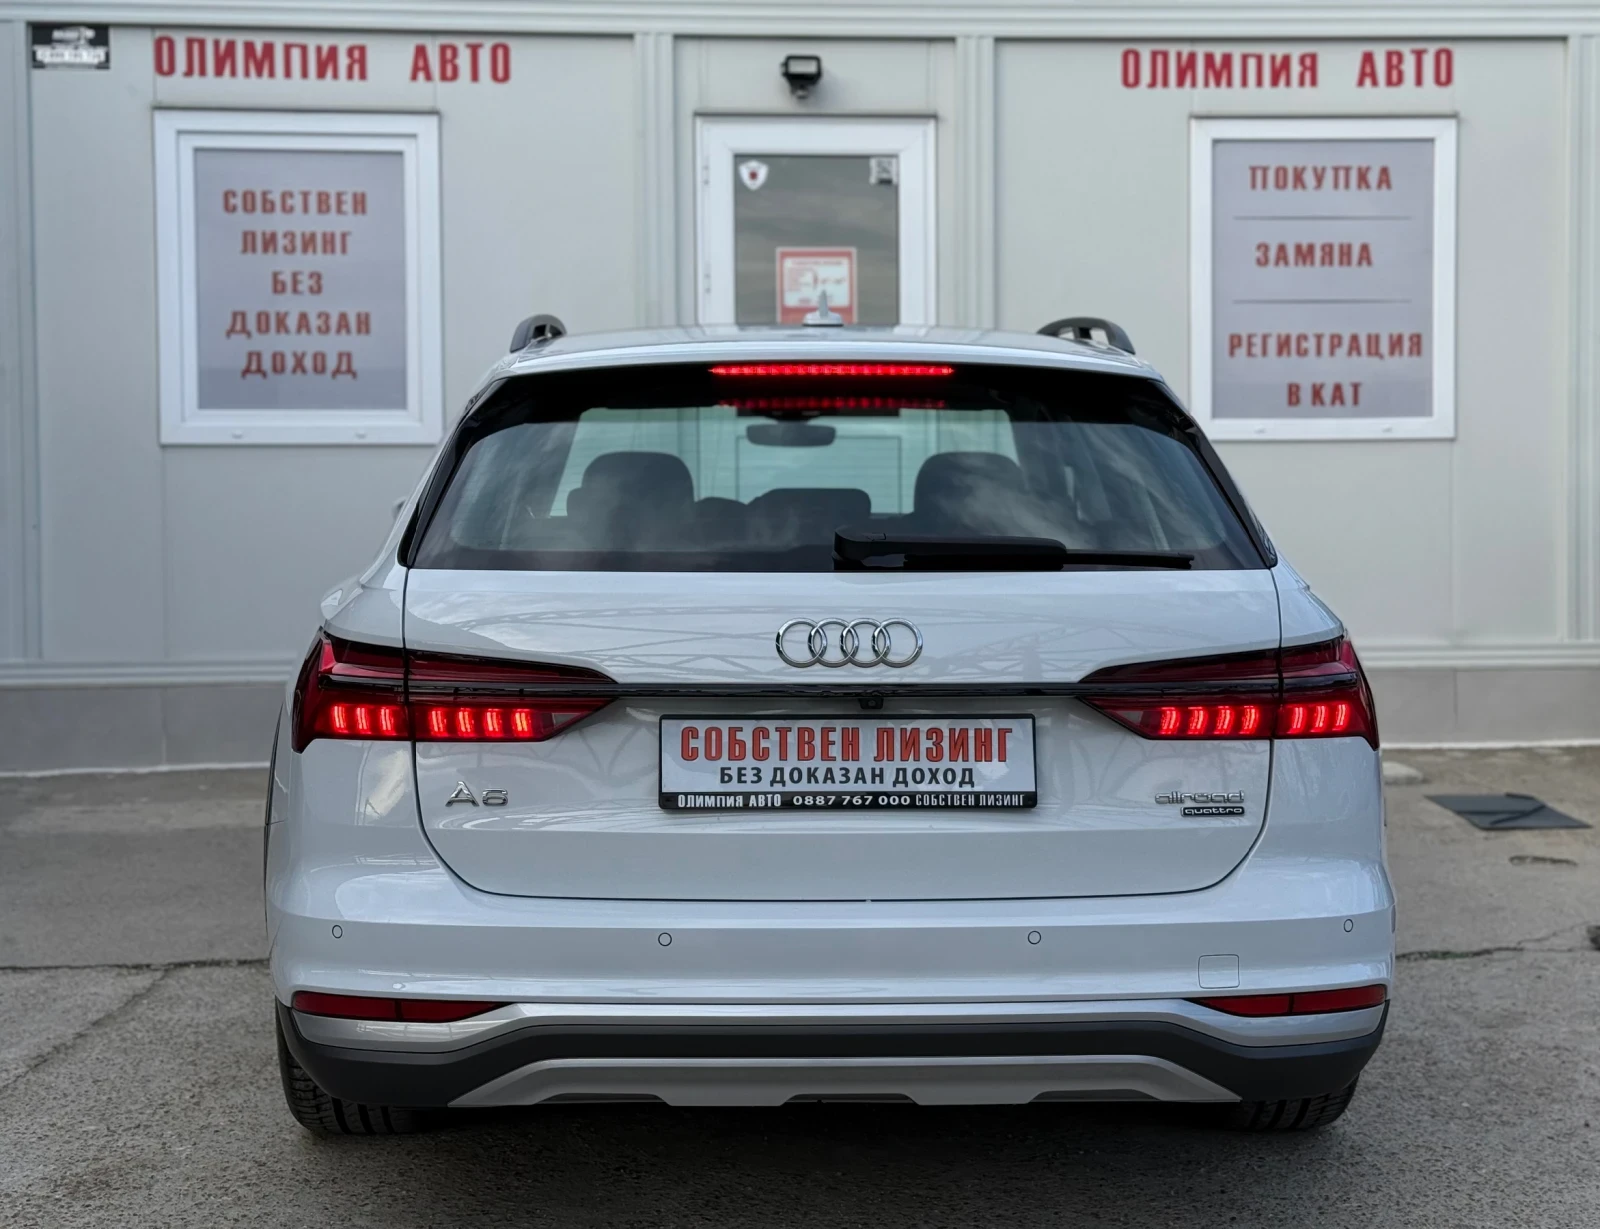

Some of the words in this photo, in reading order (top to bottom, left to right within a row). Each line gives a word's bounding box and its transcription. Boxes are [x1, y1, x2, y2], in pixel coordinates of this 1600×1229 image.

[154, 35, 368, 82] ОЛИМПИЯ
[410, 42, 512, 84] АВТО
[1121, 48, 1319, 89] ОЛИМПИЯ
[1356, 47, 1455, 88] АВТО
[1249, 165, 1393, 190] ПОКУПКА
[223, 190, 368, 216] СОБСТВЕН
[240, 231, 352, 255] ЛИЗИНГ
[1255, 242, 1373, 268] ЗАМЯНА
[272, 271, 324, 296] БЕЗ
[225, 311, 373, 339] ДОКАЗАН
[1228, 333, 1423, 361] РЕГИСТРАЦИЯ
[241, 351, 359, 380] ДОХОД
[1287, 383, 1302, 407] В
[1310, 383, 1363, 407] КАТ
[681, 726, 860, 761] СОБСТВЕН
[873, 727, 1013, 762] ЛИЗИНГ
[720, 767, 763, 784] БЕЗ
[769, 767, 885, 787] ДОКАЗАН
[893, 767, 975, 788] ДОХОД
[445, 781, 508, 807] A6
[677, 794, 744, 808] ОЛИМПИЯ
[748, 793, 782, 808] АВТО
[793, 795, 836, 806] 0887
[841, 795, 873, 806] 767
[877, 795, 911, 806] 000
[915, 794, 975, 807] СОБСТВЕН
[979, 794, 1025, 807] ЛИЗИНГ
[1155, 791, 1245, 804] allroad
[1184, 807, 1243, 815] quattro
